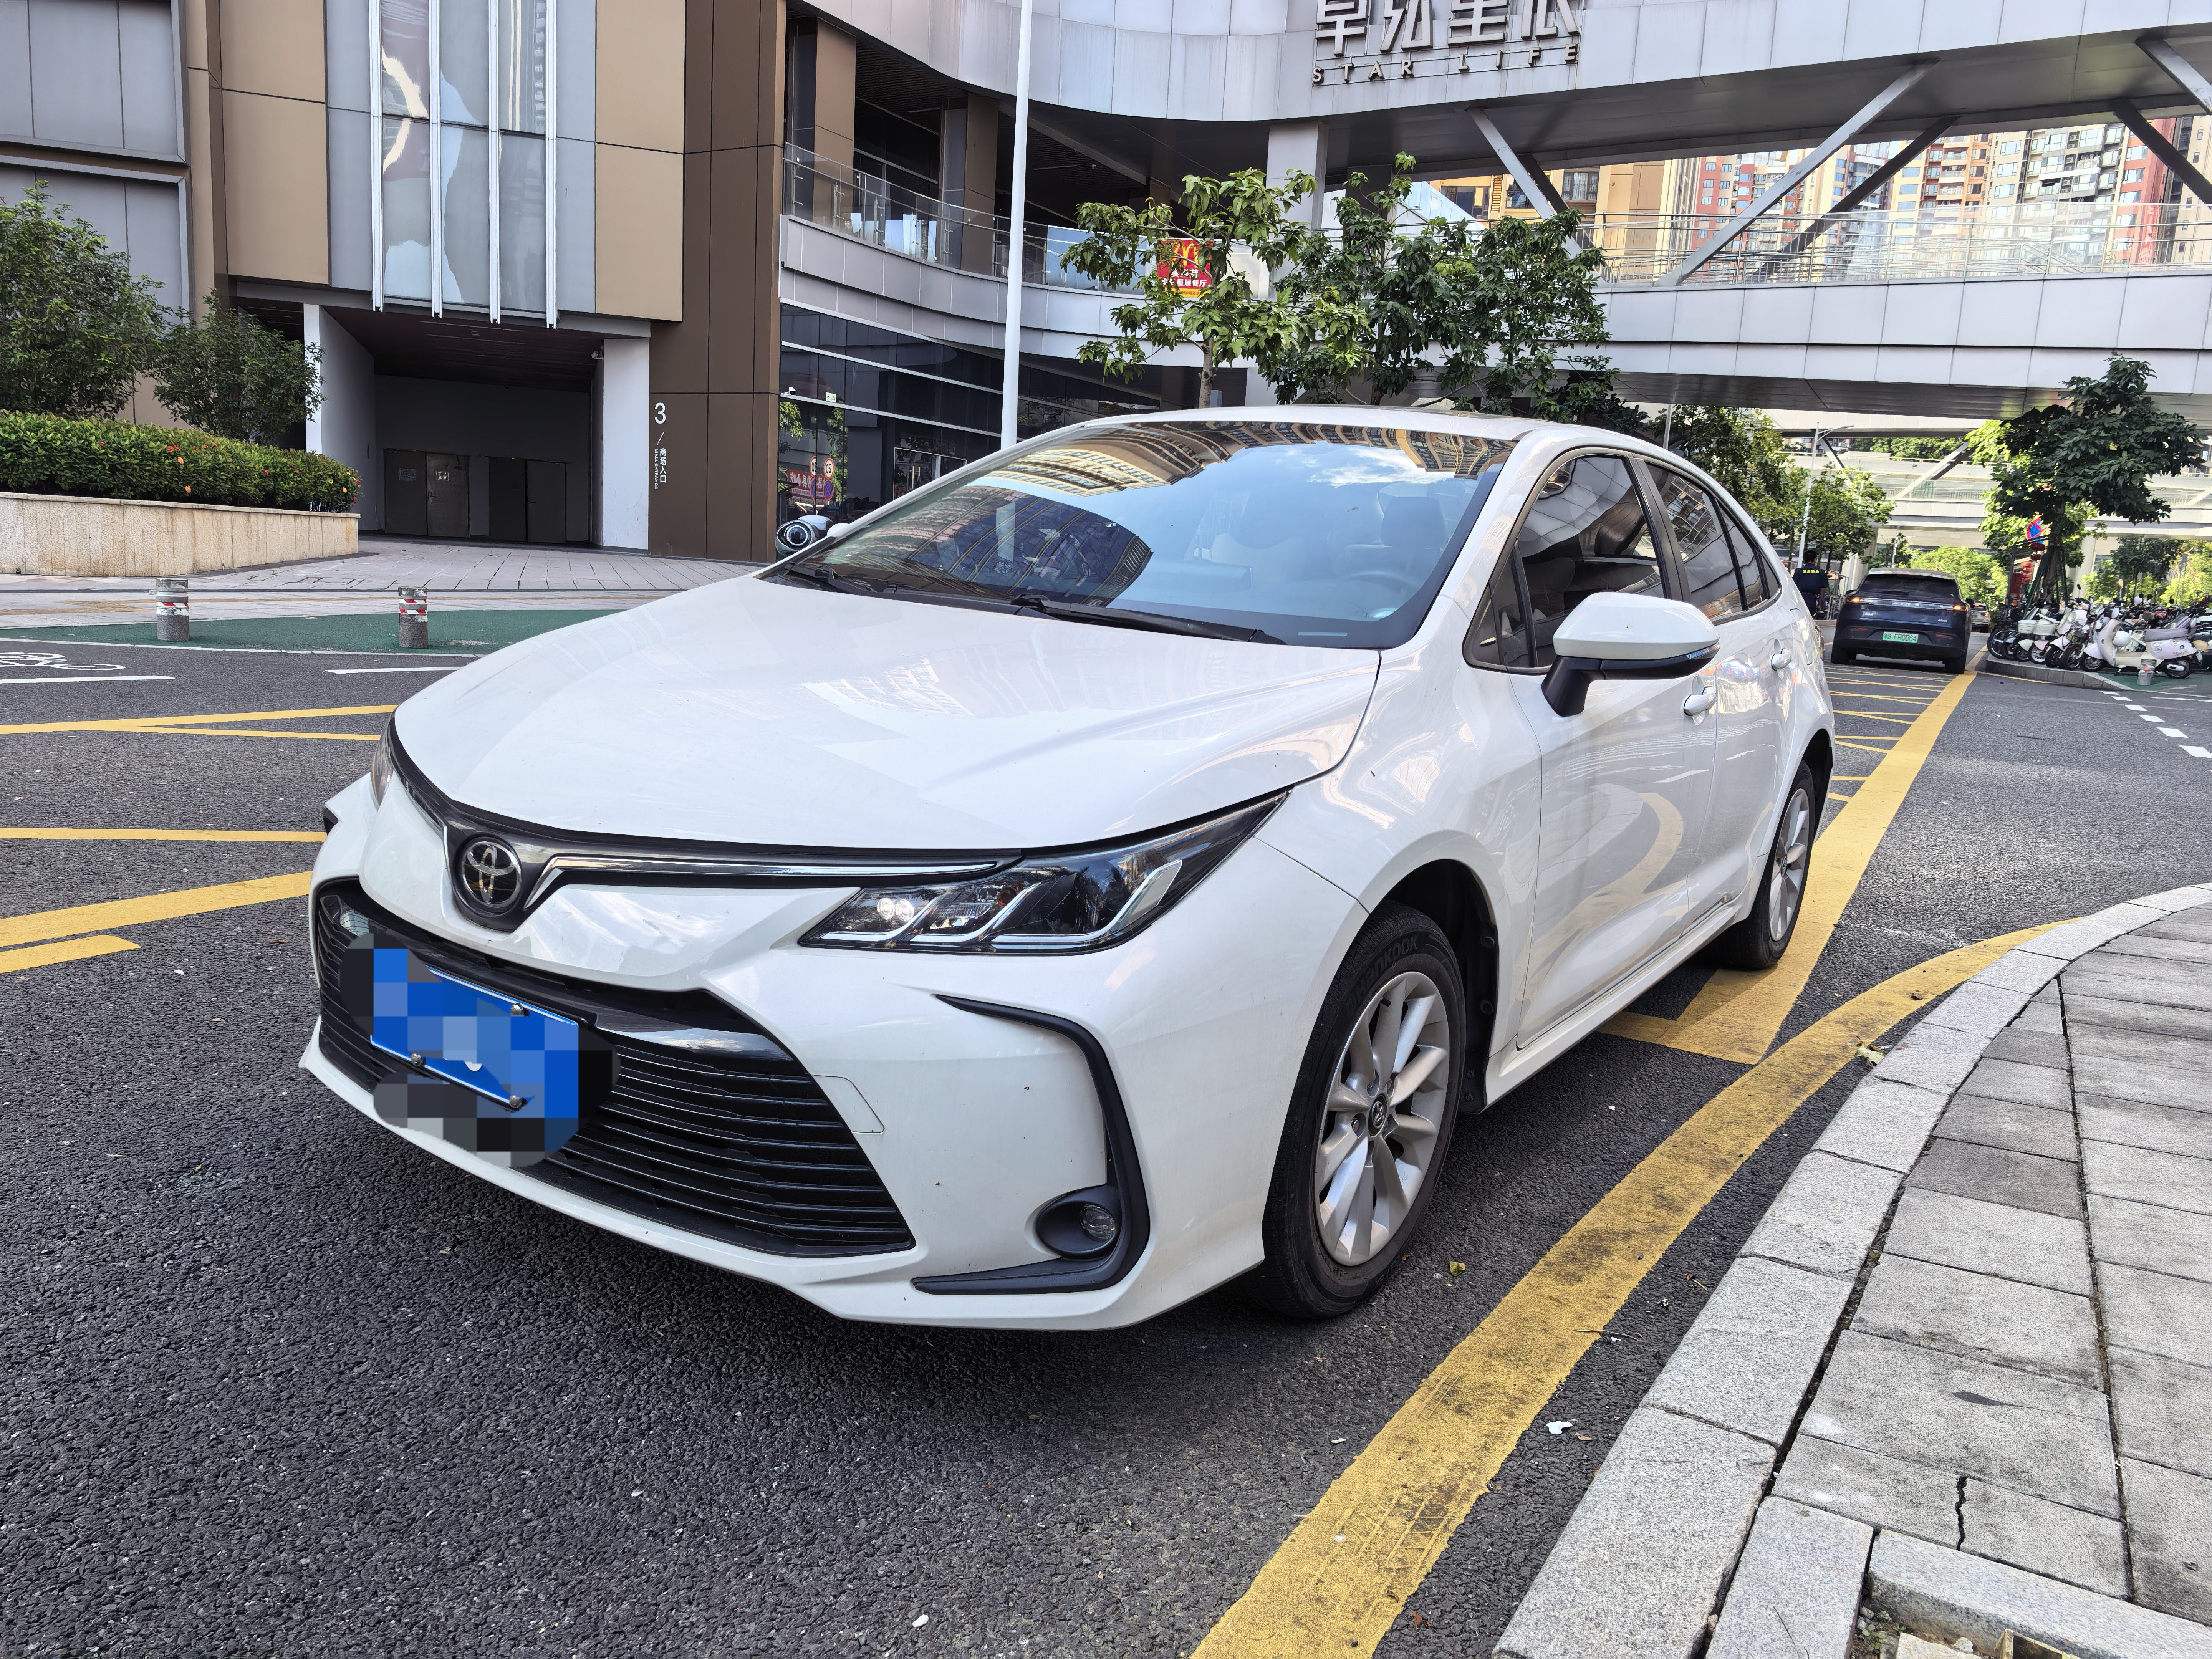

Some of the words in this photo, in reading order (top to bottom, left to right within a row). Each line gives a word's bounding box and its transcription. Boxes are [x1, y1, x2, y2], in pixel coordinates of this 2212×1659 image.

[1312, 60, 1414, 83] STAR
[1459, 43, 1578, 72] LIFE
[654, 402, 666, 424] 3
